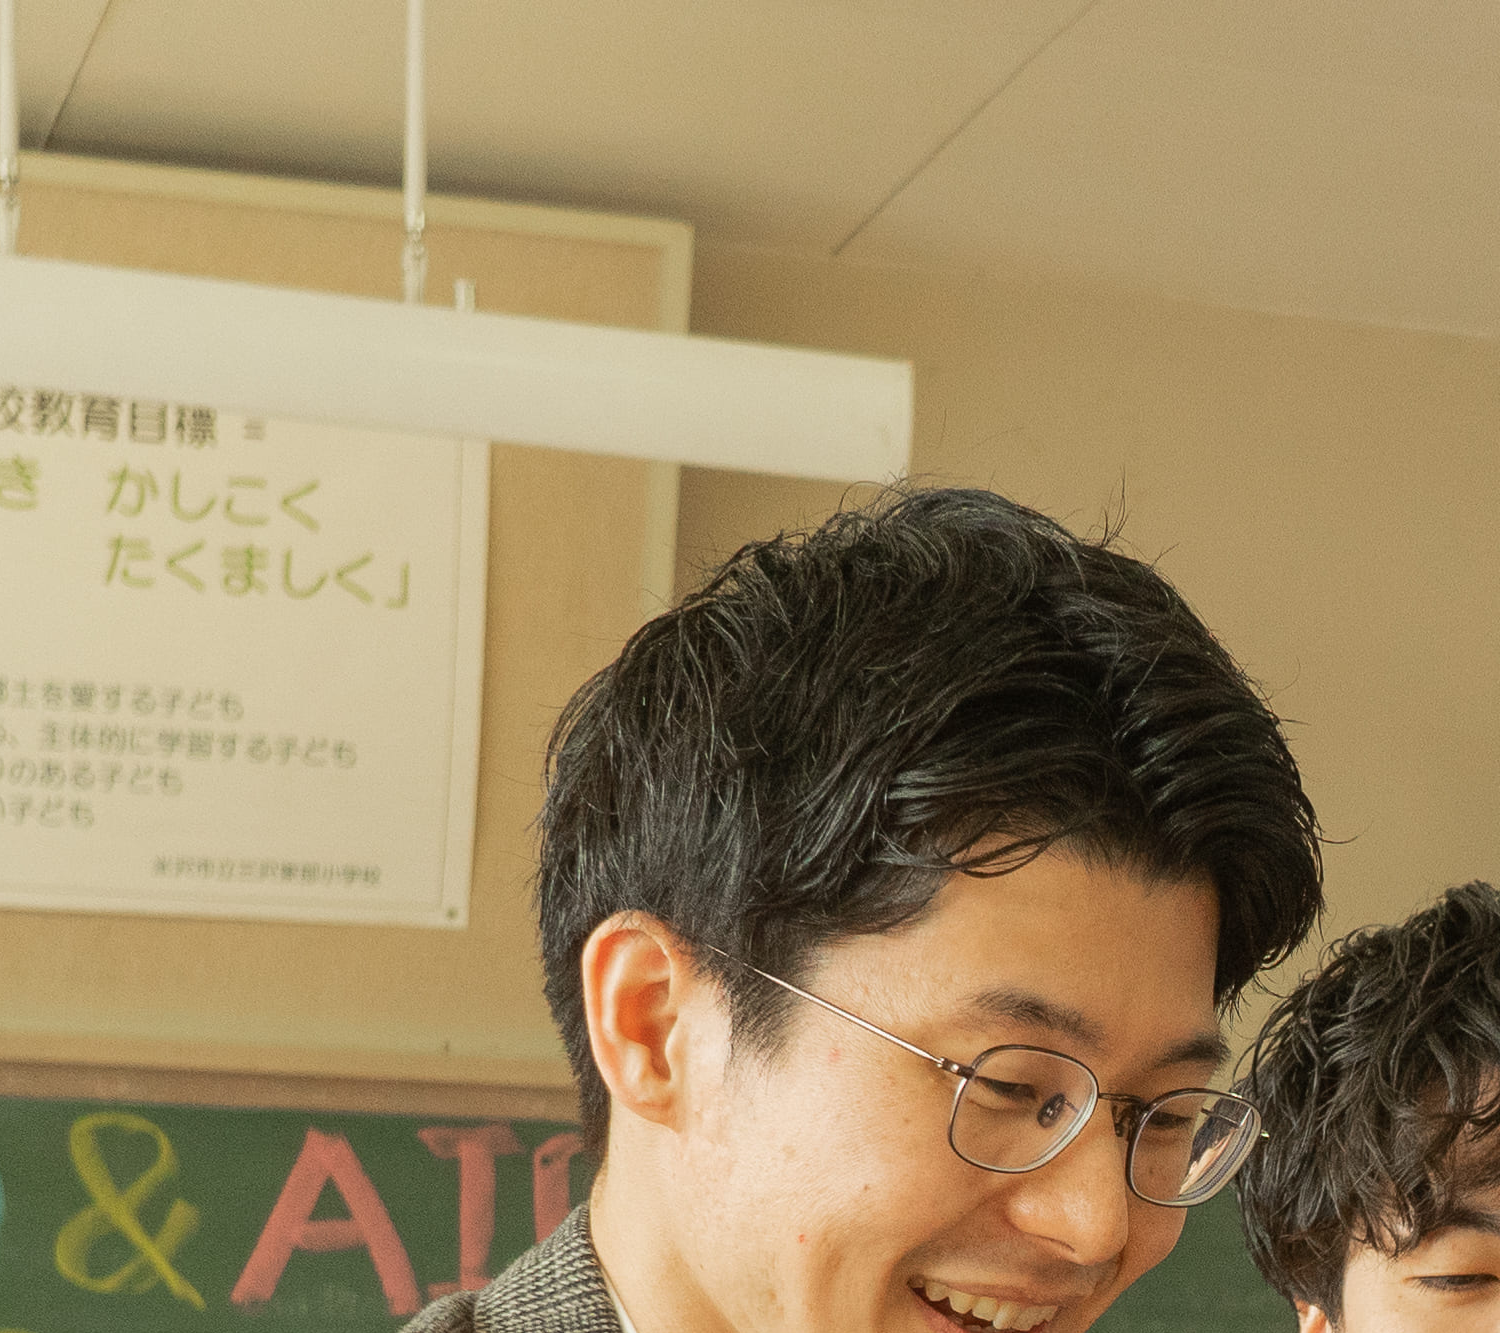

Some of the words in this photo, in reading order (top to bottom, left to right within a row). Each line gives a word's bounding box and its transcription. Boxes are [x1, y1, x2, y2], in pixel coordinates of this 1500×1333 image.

[105, 463, 320, 532] かしこく
[54, 1112, 208, 1310] &
[230, 1120, 585, 1316] AI
